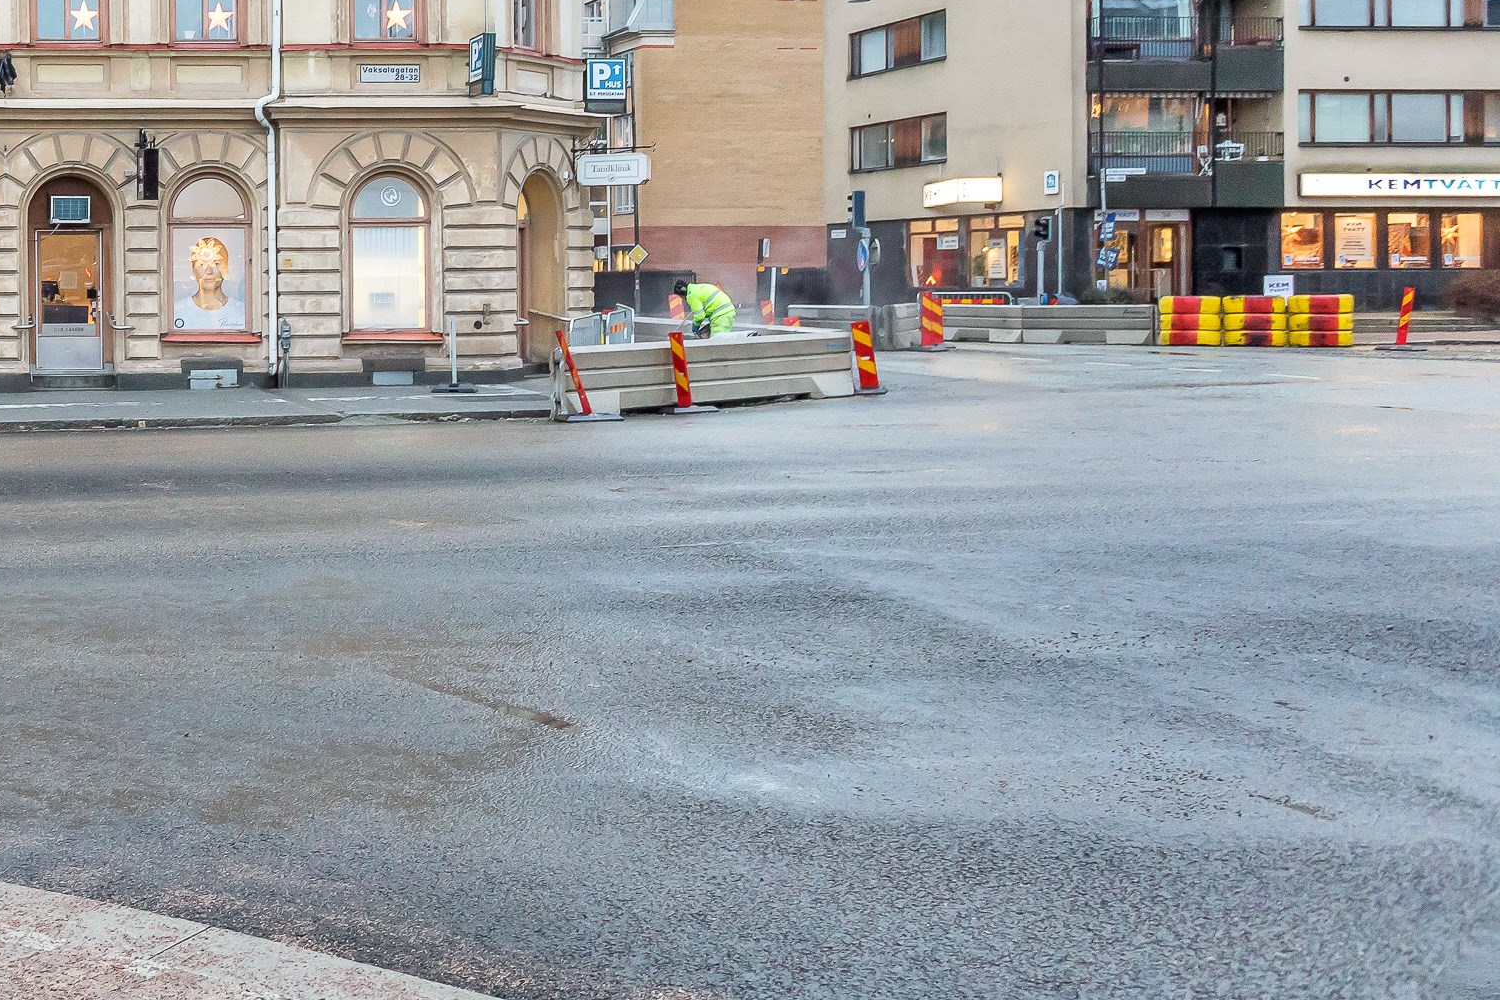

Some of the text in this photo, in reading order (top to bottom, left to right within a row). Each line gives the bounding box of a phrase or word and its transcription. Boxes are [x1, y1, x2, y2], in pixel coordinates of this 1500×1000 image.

[362, 66, 418, 75] Vaksalagatan
[592, 63, 611, 88] P
[591, 164, 632, 173] Tandklinik
[1368, 176, 1500, 190] KEMTVÄTT
